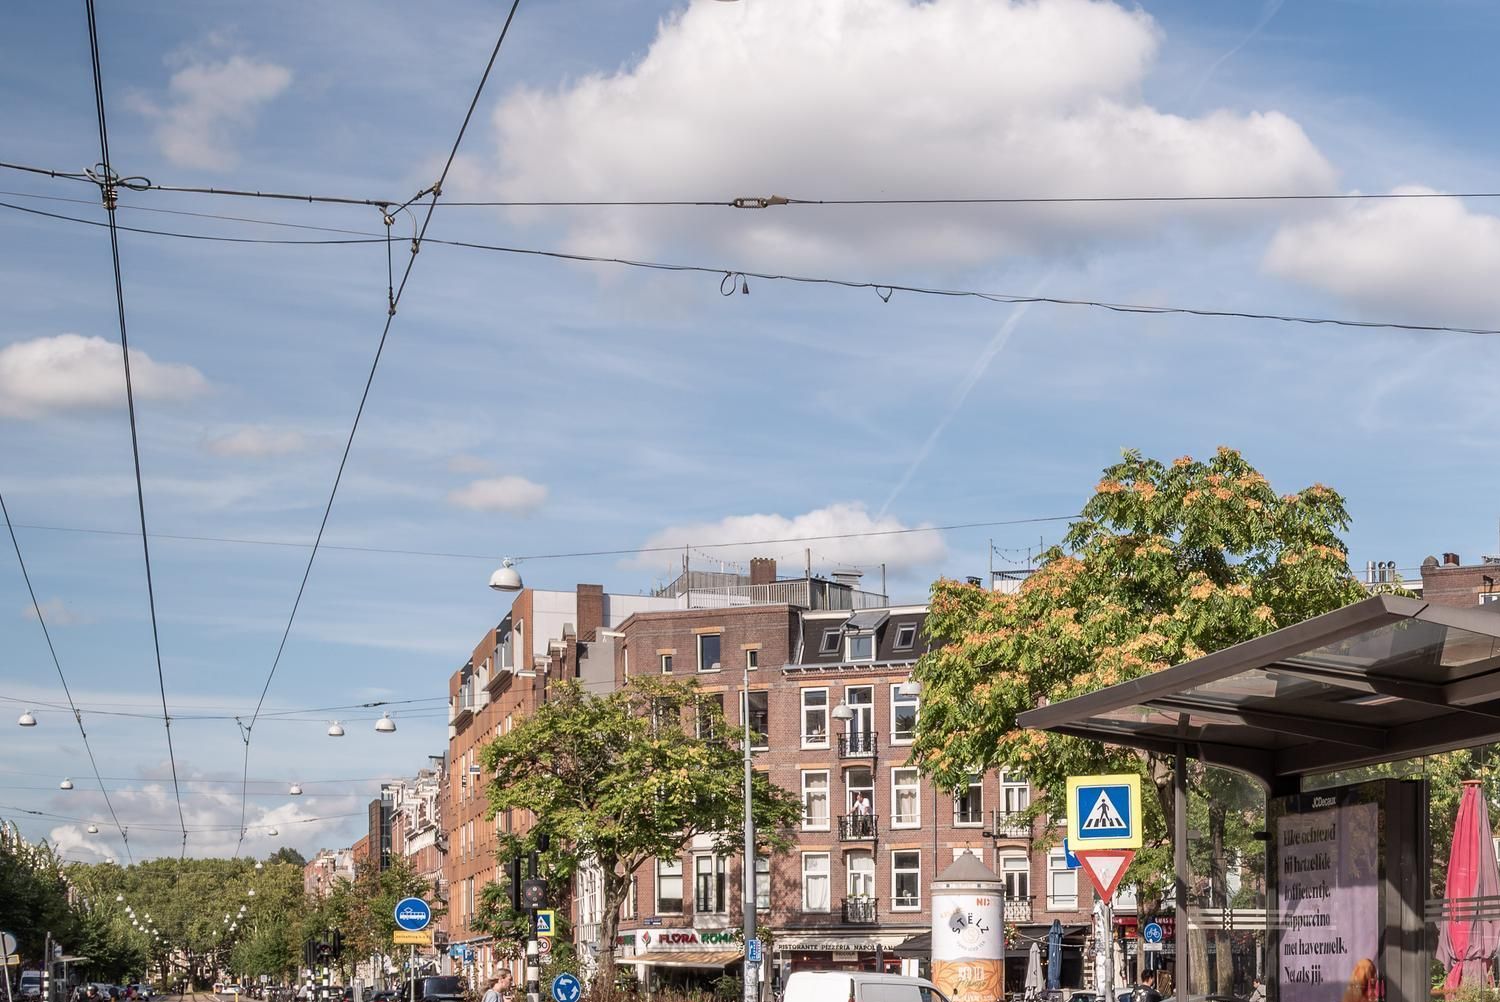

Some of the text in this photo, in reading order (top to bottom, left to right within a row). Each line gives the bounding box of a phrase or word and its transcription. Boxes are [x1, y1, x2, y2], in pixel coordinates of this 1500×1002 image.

[1283, 823, 1336, 847] Elke ochtend
[1284, 854, 1293, 876] bij
[659, 933, 698, 944] FLORA
[1284, 937, 1348, 956] met havermelk.
[1296, 966, 1310, 984] als
[1311, 964, 1324, 986] jij.
